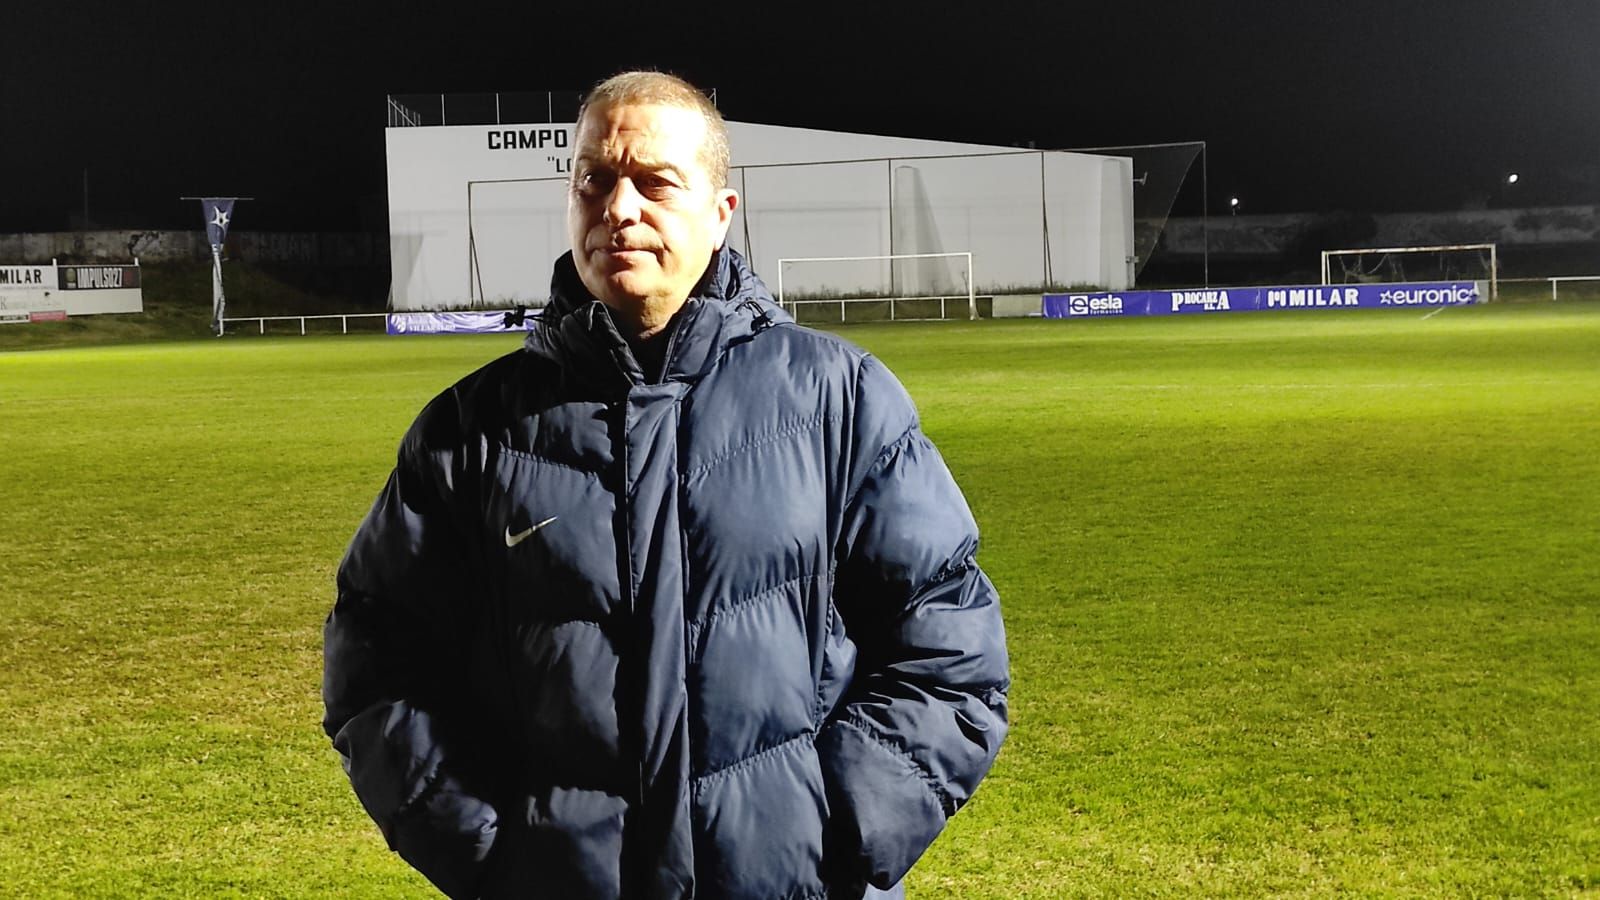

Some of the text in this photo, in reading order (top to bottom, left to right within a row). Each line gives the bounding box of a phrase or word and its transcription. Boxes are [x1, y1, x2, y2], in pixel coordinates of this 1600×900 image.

[487, 129, 568, 149] CAMPO
[1089, 294, 1122, 309] esla
[1289, 288, 1359, 306] MILAR
